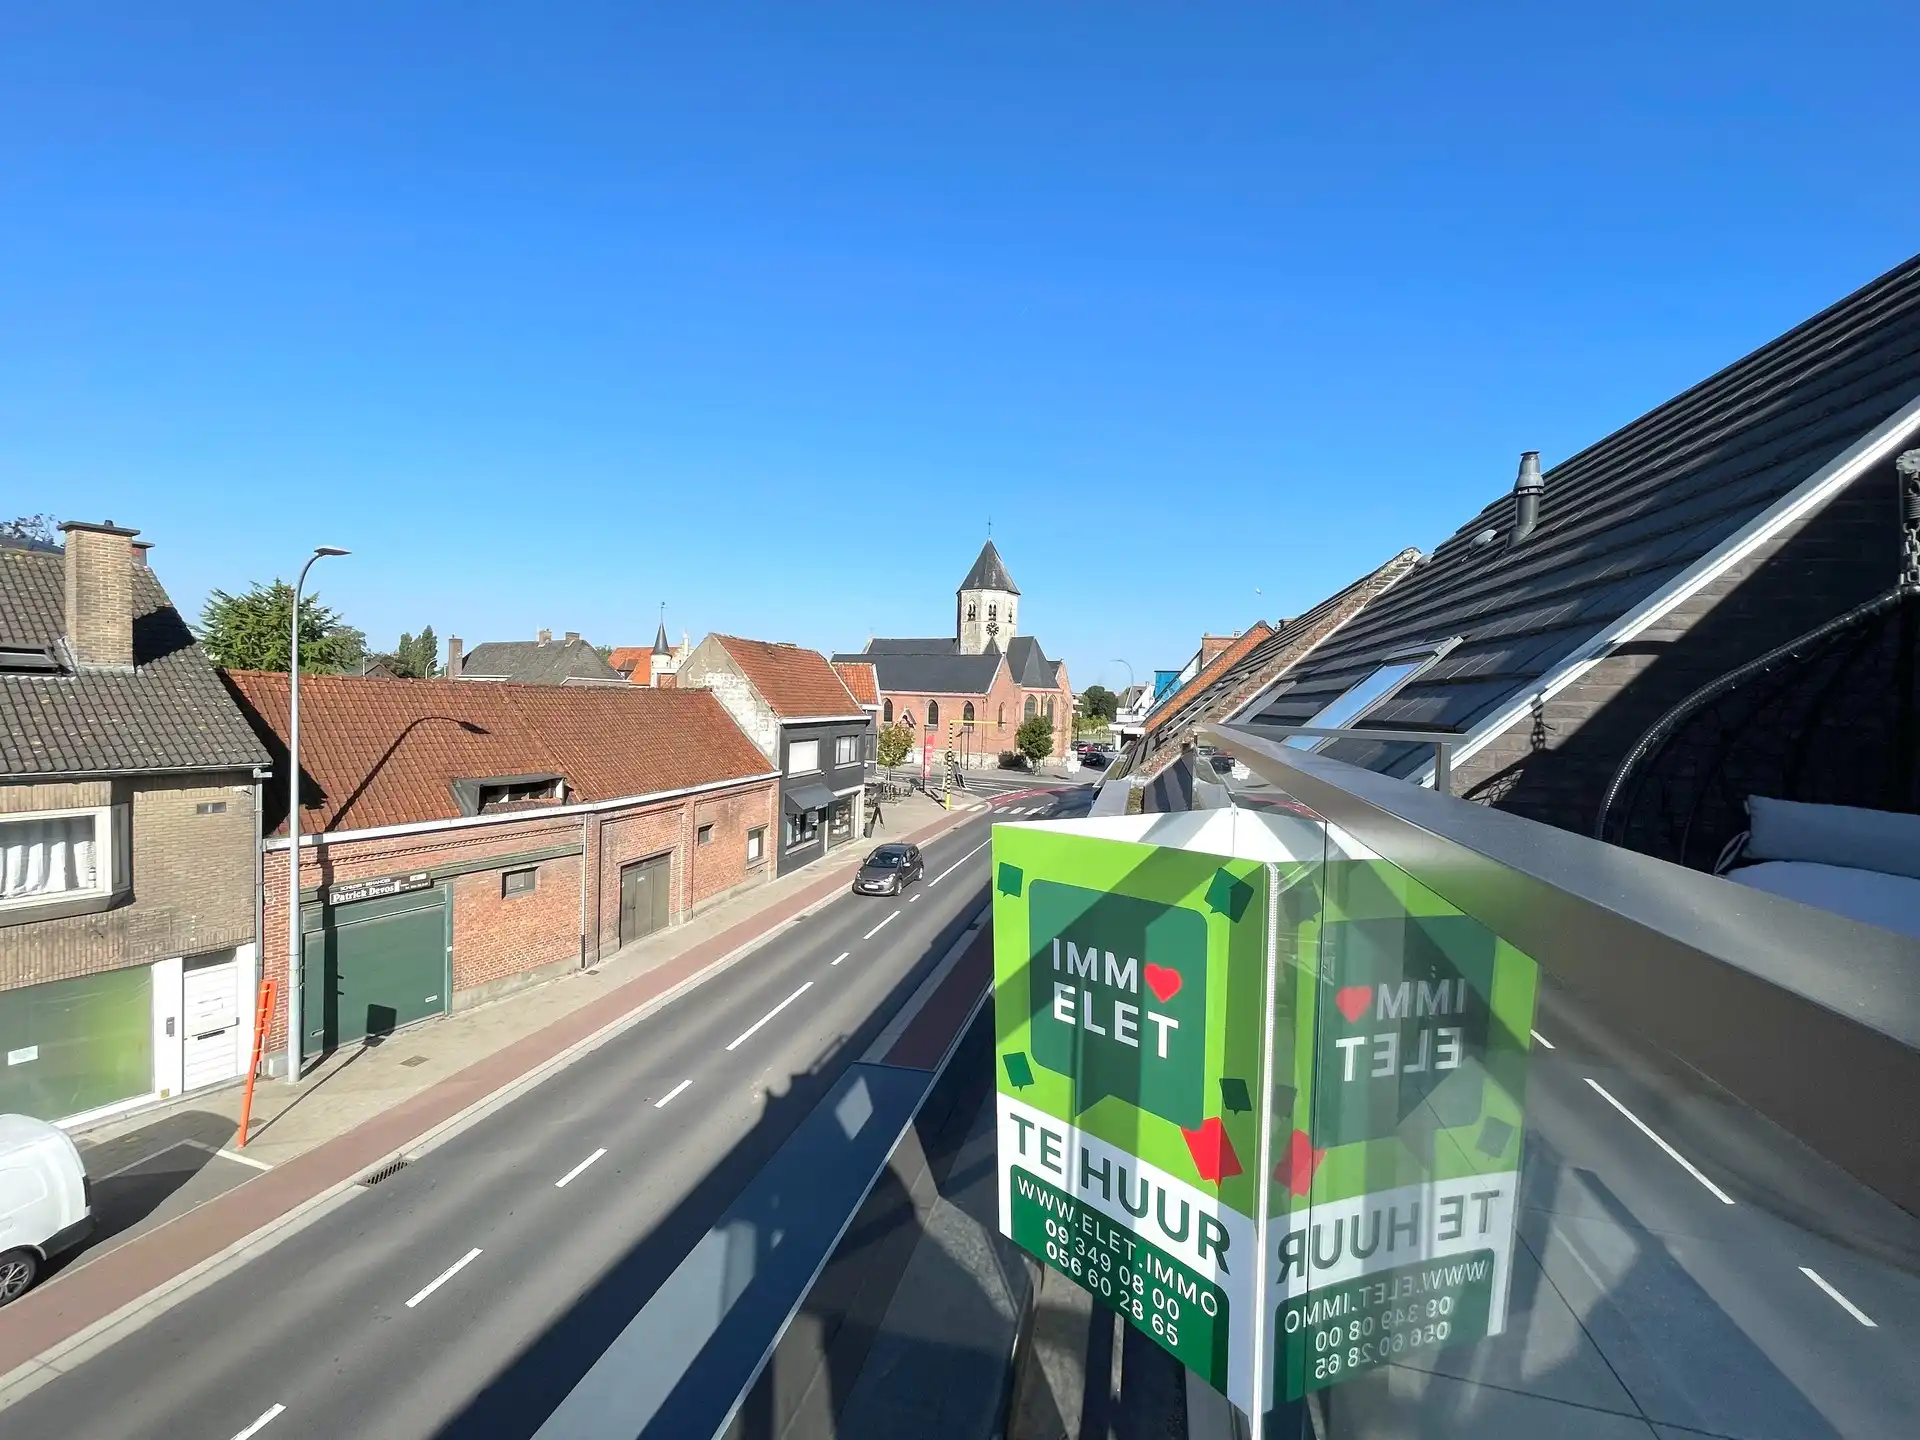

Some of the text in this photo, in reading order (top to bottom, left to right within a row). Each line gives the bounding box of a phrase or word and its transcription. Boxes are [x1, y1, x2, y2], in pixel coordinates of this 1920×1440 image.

[332, 889, 367, 903] Patrick
[369, 886, 394, 896] Devos
[1053, 981, 1179, 1059] ELET
[1010, 1112, 1231, 1276] TE HUUR
[1017, 1175, 1218, 1317] WWW.ELET.IMMO
[1045, 1218, 1180, 1321] 09 349 08 00
[1045, 1241, 1178, 1346] 056 60 28 65
